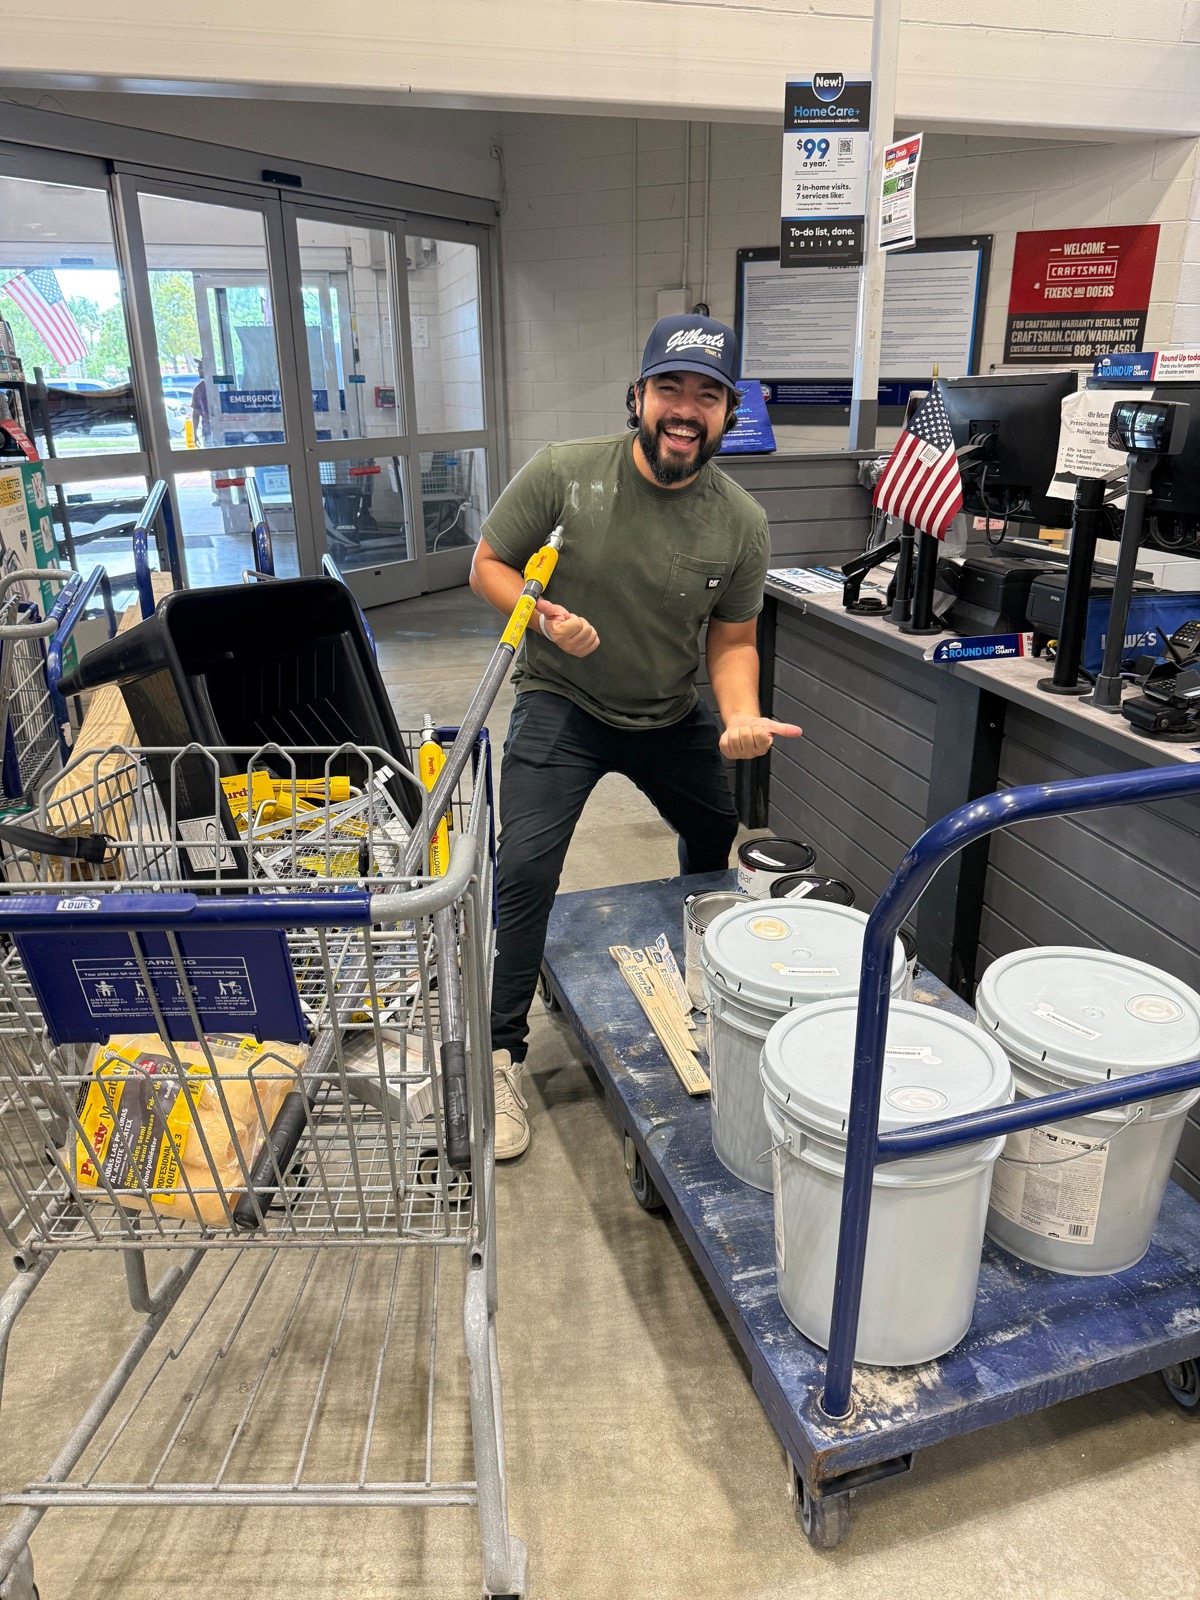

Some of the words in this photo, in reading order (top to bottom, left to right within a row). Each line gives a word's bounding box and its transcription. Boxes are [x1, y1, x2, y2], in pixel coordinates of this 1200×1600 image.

[816, 76, 841, 87] New!
[794, 105, 860, 117] HomeCare+
[796, 138, 830, 160] $99
[790, 228, 814, 236] To-do
[815, 227, 830, 237] list,
[832, 227, 855, 235] done.
[1064, 242, 1106, 255] WELCOME
[1051, 265, 1112, 277] CRAFTSMAN
[1044, 286, 1073, 299] FIXERS
[1074, 287, 1085, 295] AND
[1086, 285, 1114, 297] DOERS
[1012, 320, 1024, 329] FOR
[1025, 319, 1060, 328] CRAFTSMAN
[1061, 319, 1094, 328] WARRANTY
[1095, 318, 1121, 327] DETAILS,
[1123, 318, 1140, 327] VISIT
[665, 328, 724, 353] Gilbert's
[1011, 329, 1138, 343] CRAFTSMAN.COM/WARRANTY
[1010, 345, 1037, 353] CUSTOMER
[1161, 354, 1178, 362] Round
[1179, 354, 1186, 362] Up
[1188, 353, 1200, 361] toda
[1102, 366, 1124, 376] ROUND
[1124, 366, 1134, 376] UP
[230, 395, 277, 403] EMERGENCY
[1101, 631, 1157, 650] LWE'S
[949, 648, 982, 658] ROUND
[983, 646, 995, 655] UP
[432, 845, 441, 877] RALLONG
[61, 899, 97, 909] LOWE'S
[635, 972, 646, 985] Every
[644, 986, 654, 997] Day
[100, 1062, 124, 1119] Mraton
[138, 1126, 146, 1143] semi
[140, 1144, 148, 1162] semi
[146, 1114, 155, 1143] rugosas
[110, 1143, 118, 1157] LAS
[110, 1174, 117, 1183] AL
[114, 1148, 123, 1173] ACEITE
[143, 1137, 158, 1187] ylon/poliéster
[157, 1145, 171, 1188] ROFESIONAL
